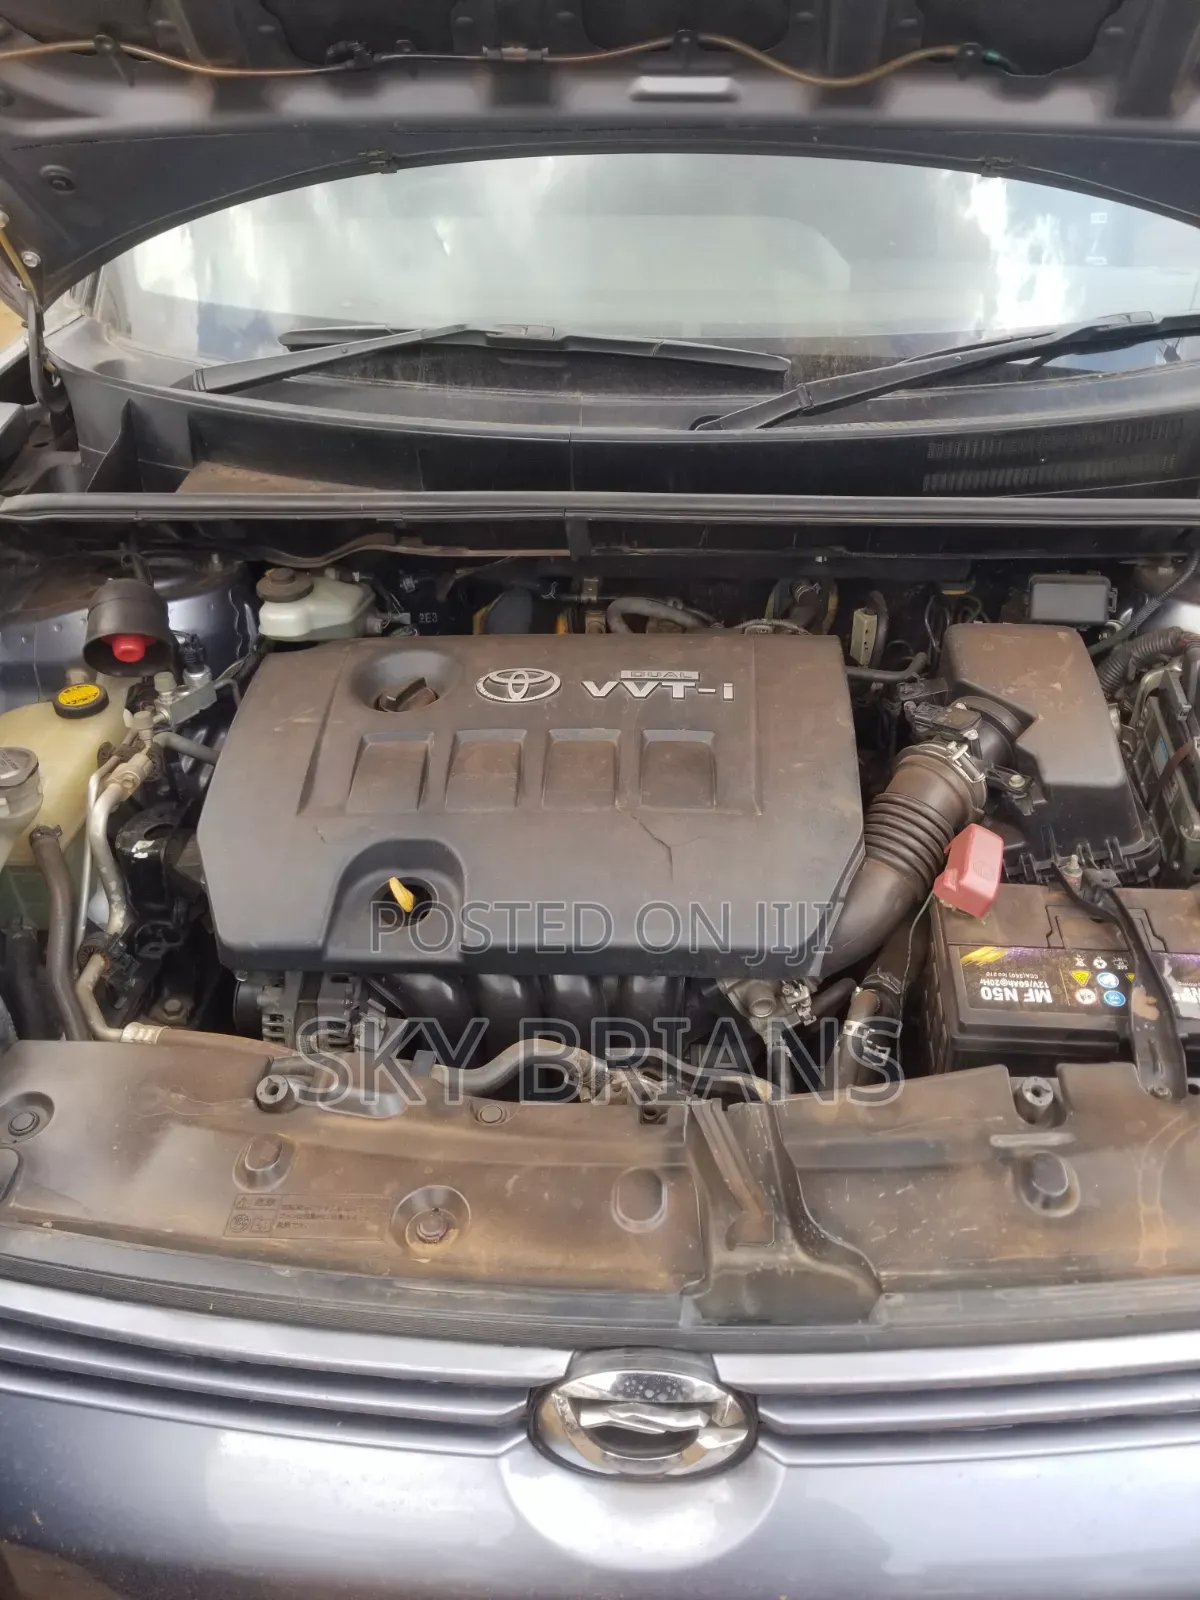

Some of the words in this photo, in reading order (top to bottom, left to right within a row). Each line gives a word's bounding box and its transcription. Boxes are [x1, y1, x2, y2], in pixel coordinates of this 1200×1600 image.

[627, 671, 695, 679] DUAL
[581, 681, 735, 701] VVT-i
[980, 986, 1019, 1002] N50
[1024, 988, 1053, 1003] MF
